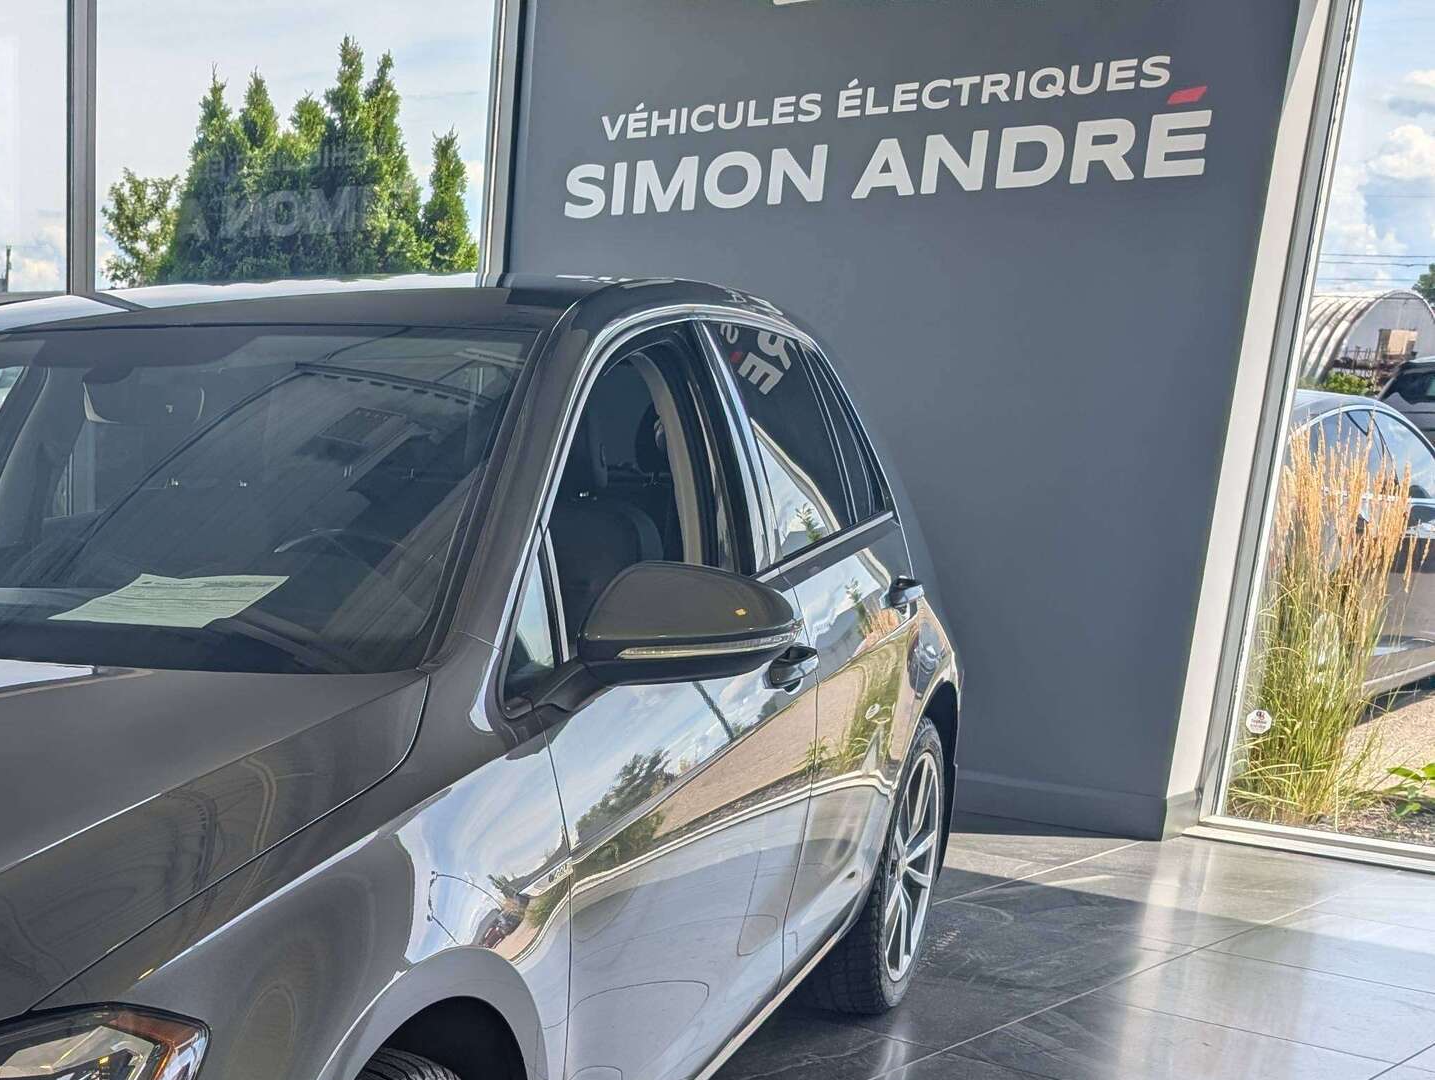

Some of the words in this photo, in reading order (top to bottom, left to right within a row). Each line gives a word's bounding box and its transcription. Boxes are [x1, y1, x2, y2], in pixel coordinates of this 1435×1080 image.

[564, 144, 828, 219] SIMON
[850, 85, 1213, 200] ANDRÉ
[601, 92, 822, 141] VÉHICULES
[836, 55, 1171, 119] ÉLECTRIQUES
